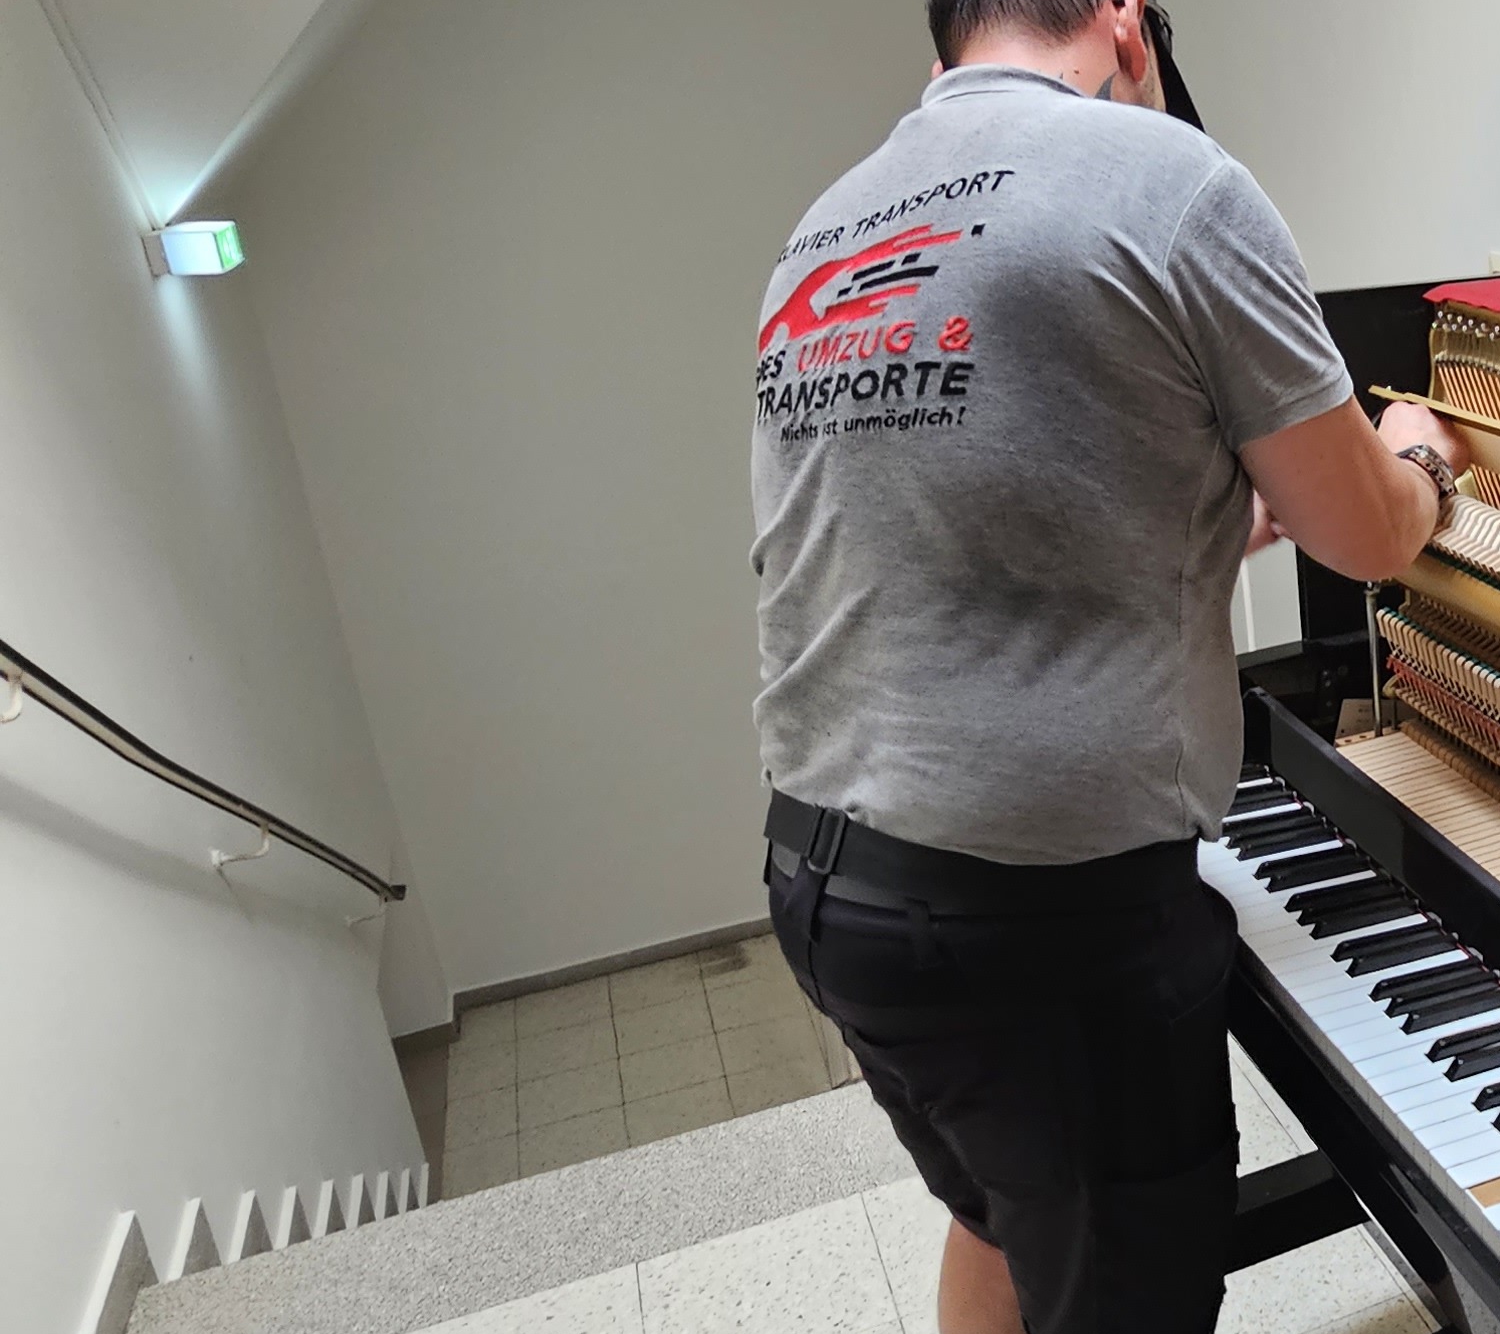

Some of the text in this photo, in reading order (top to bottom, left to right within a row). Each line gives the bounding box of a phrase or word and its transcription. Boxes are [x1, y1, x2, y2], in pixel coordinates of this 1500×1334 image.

[853, 170, 1014, 239] TRANSPORT
[757, 317, 974, 389] ES UMZUG &
[757, 361, 975, 418] TRANSPORTE
[780, 406, 967, 443] Nichts ist unmöglich!
